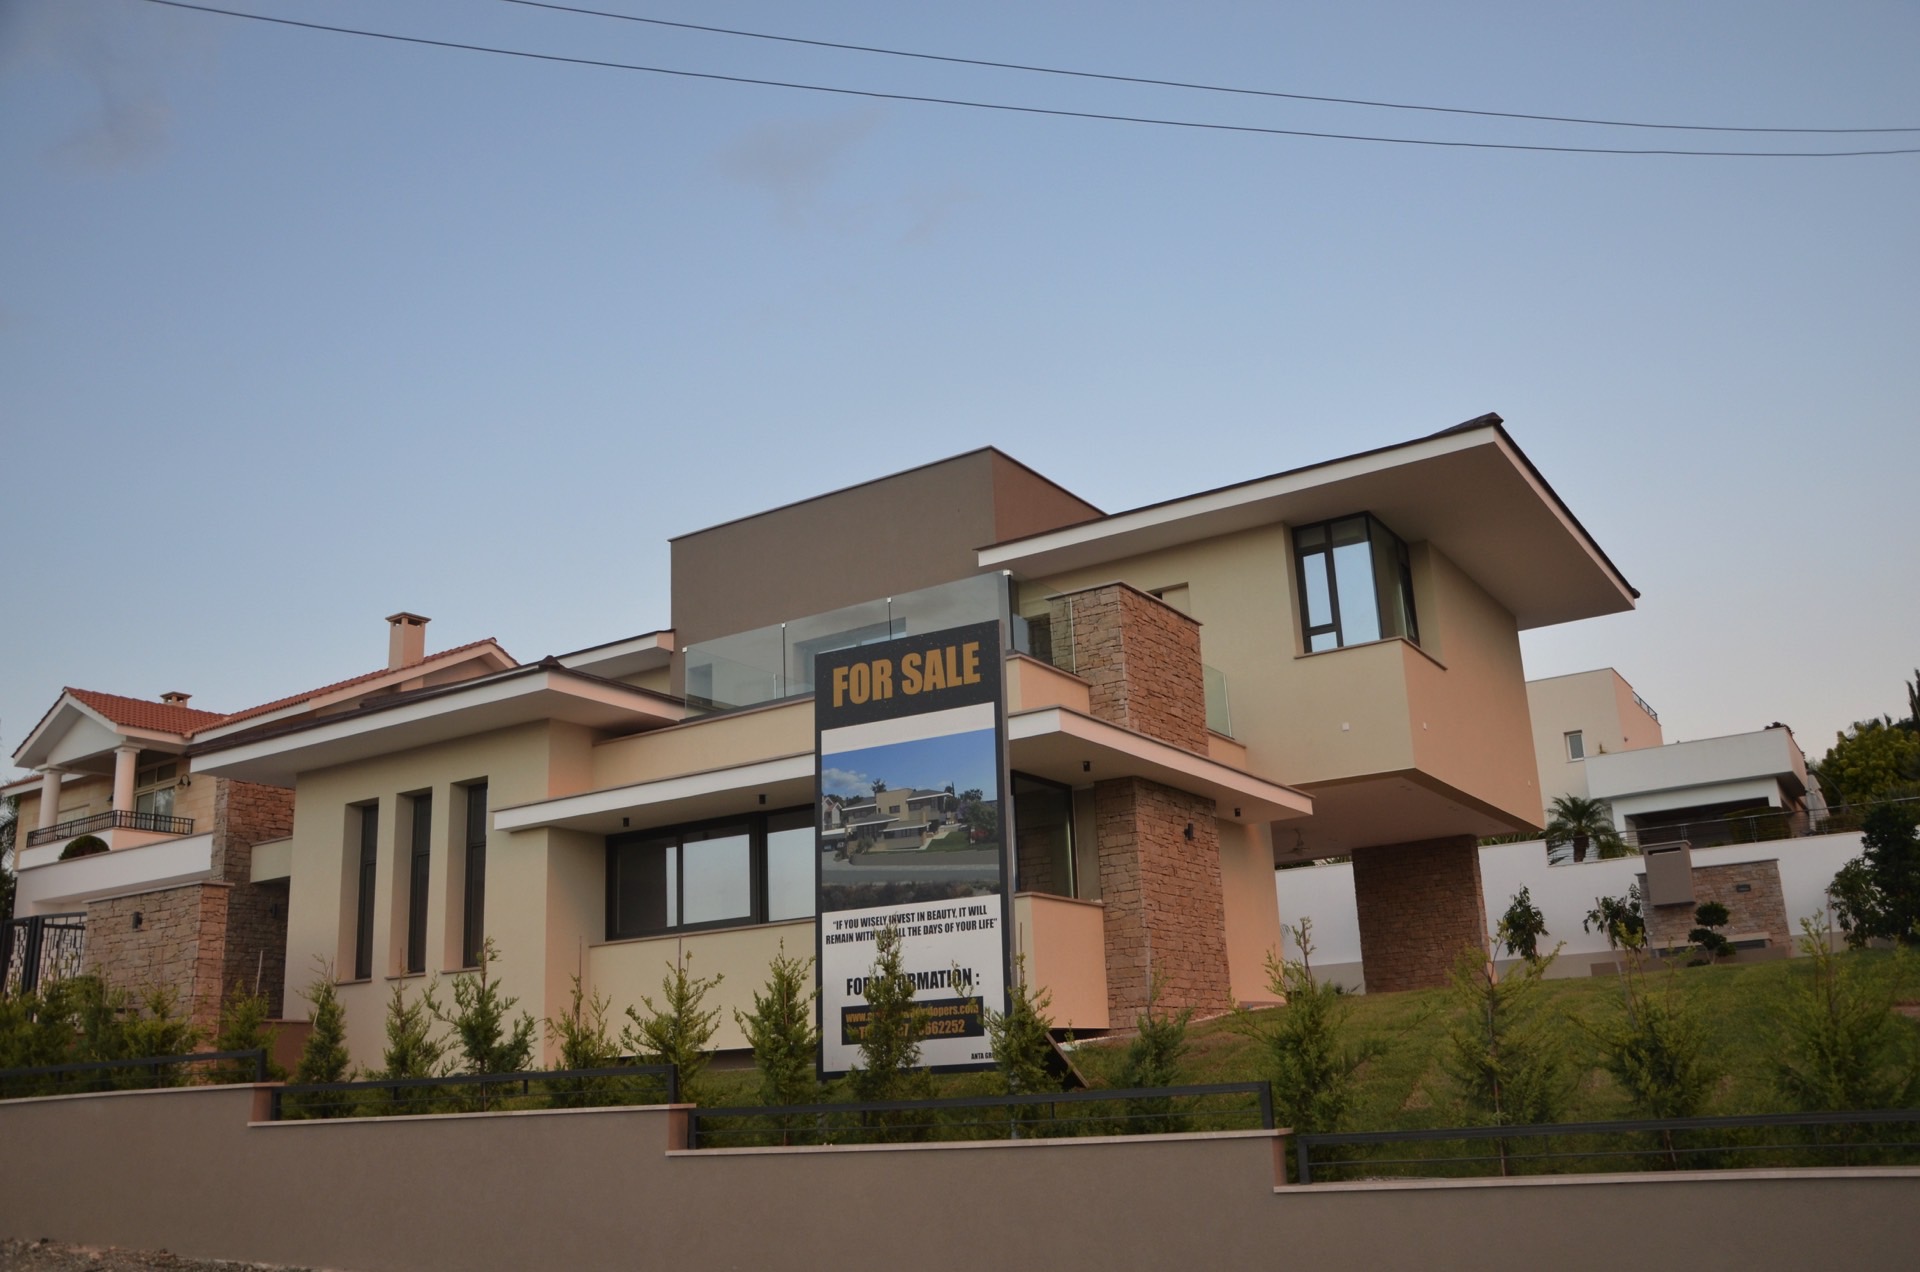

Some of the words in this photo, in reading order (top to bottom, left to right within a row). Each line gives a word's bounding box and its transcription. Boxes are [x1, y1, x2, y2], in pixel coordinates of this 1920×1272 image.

[833, 659, 893, 708] FOR
[901, 641, 981, 695] SALE
[844, 918, 859, 930] YOU
[860, 915, 887, 928] WISELY
[888, 912, 915, 925] INVEST
[917, 911, 925, 922] IN
[927, 908, 957, 920] BEAUTY,
[958, 907, 967, 917] IT
[968, 905, 987, 917] WILL
[826, 933, 854, 945] REMAIN
[855, 930, 875, 942] WITH
[908, 925, 922, 937] THE
[923, 923, 943, 935] DAYS
[944, 922, 955, 933] OF
[956, 920, 977, 932] YOUR
[971, 1052, 984, 1060] ANTA
